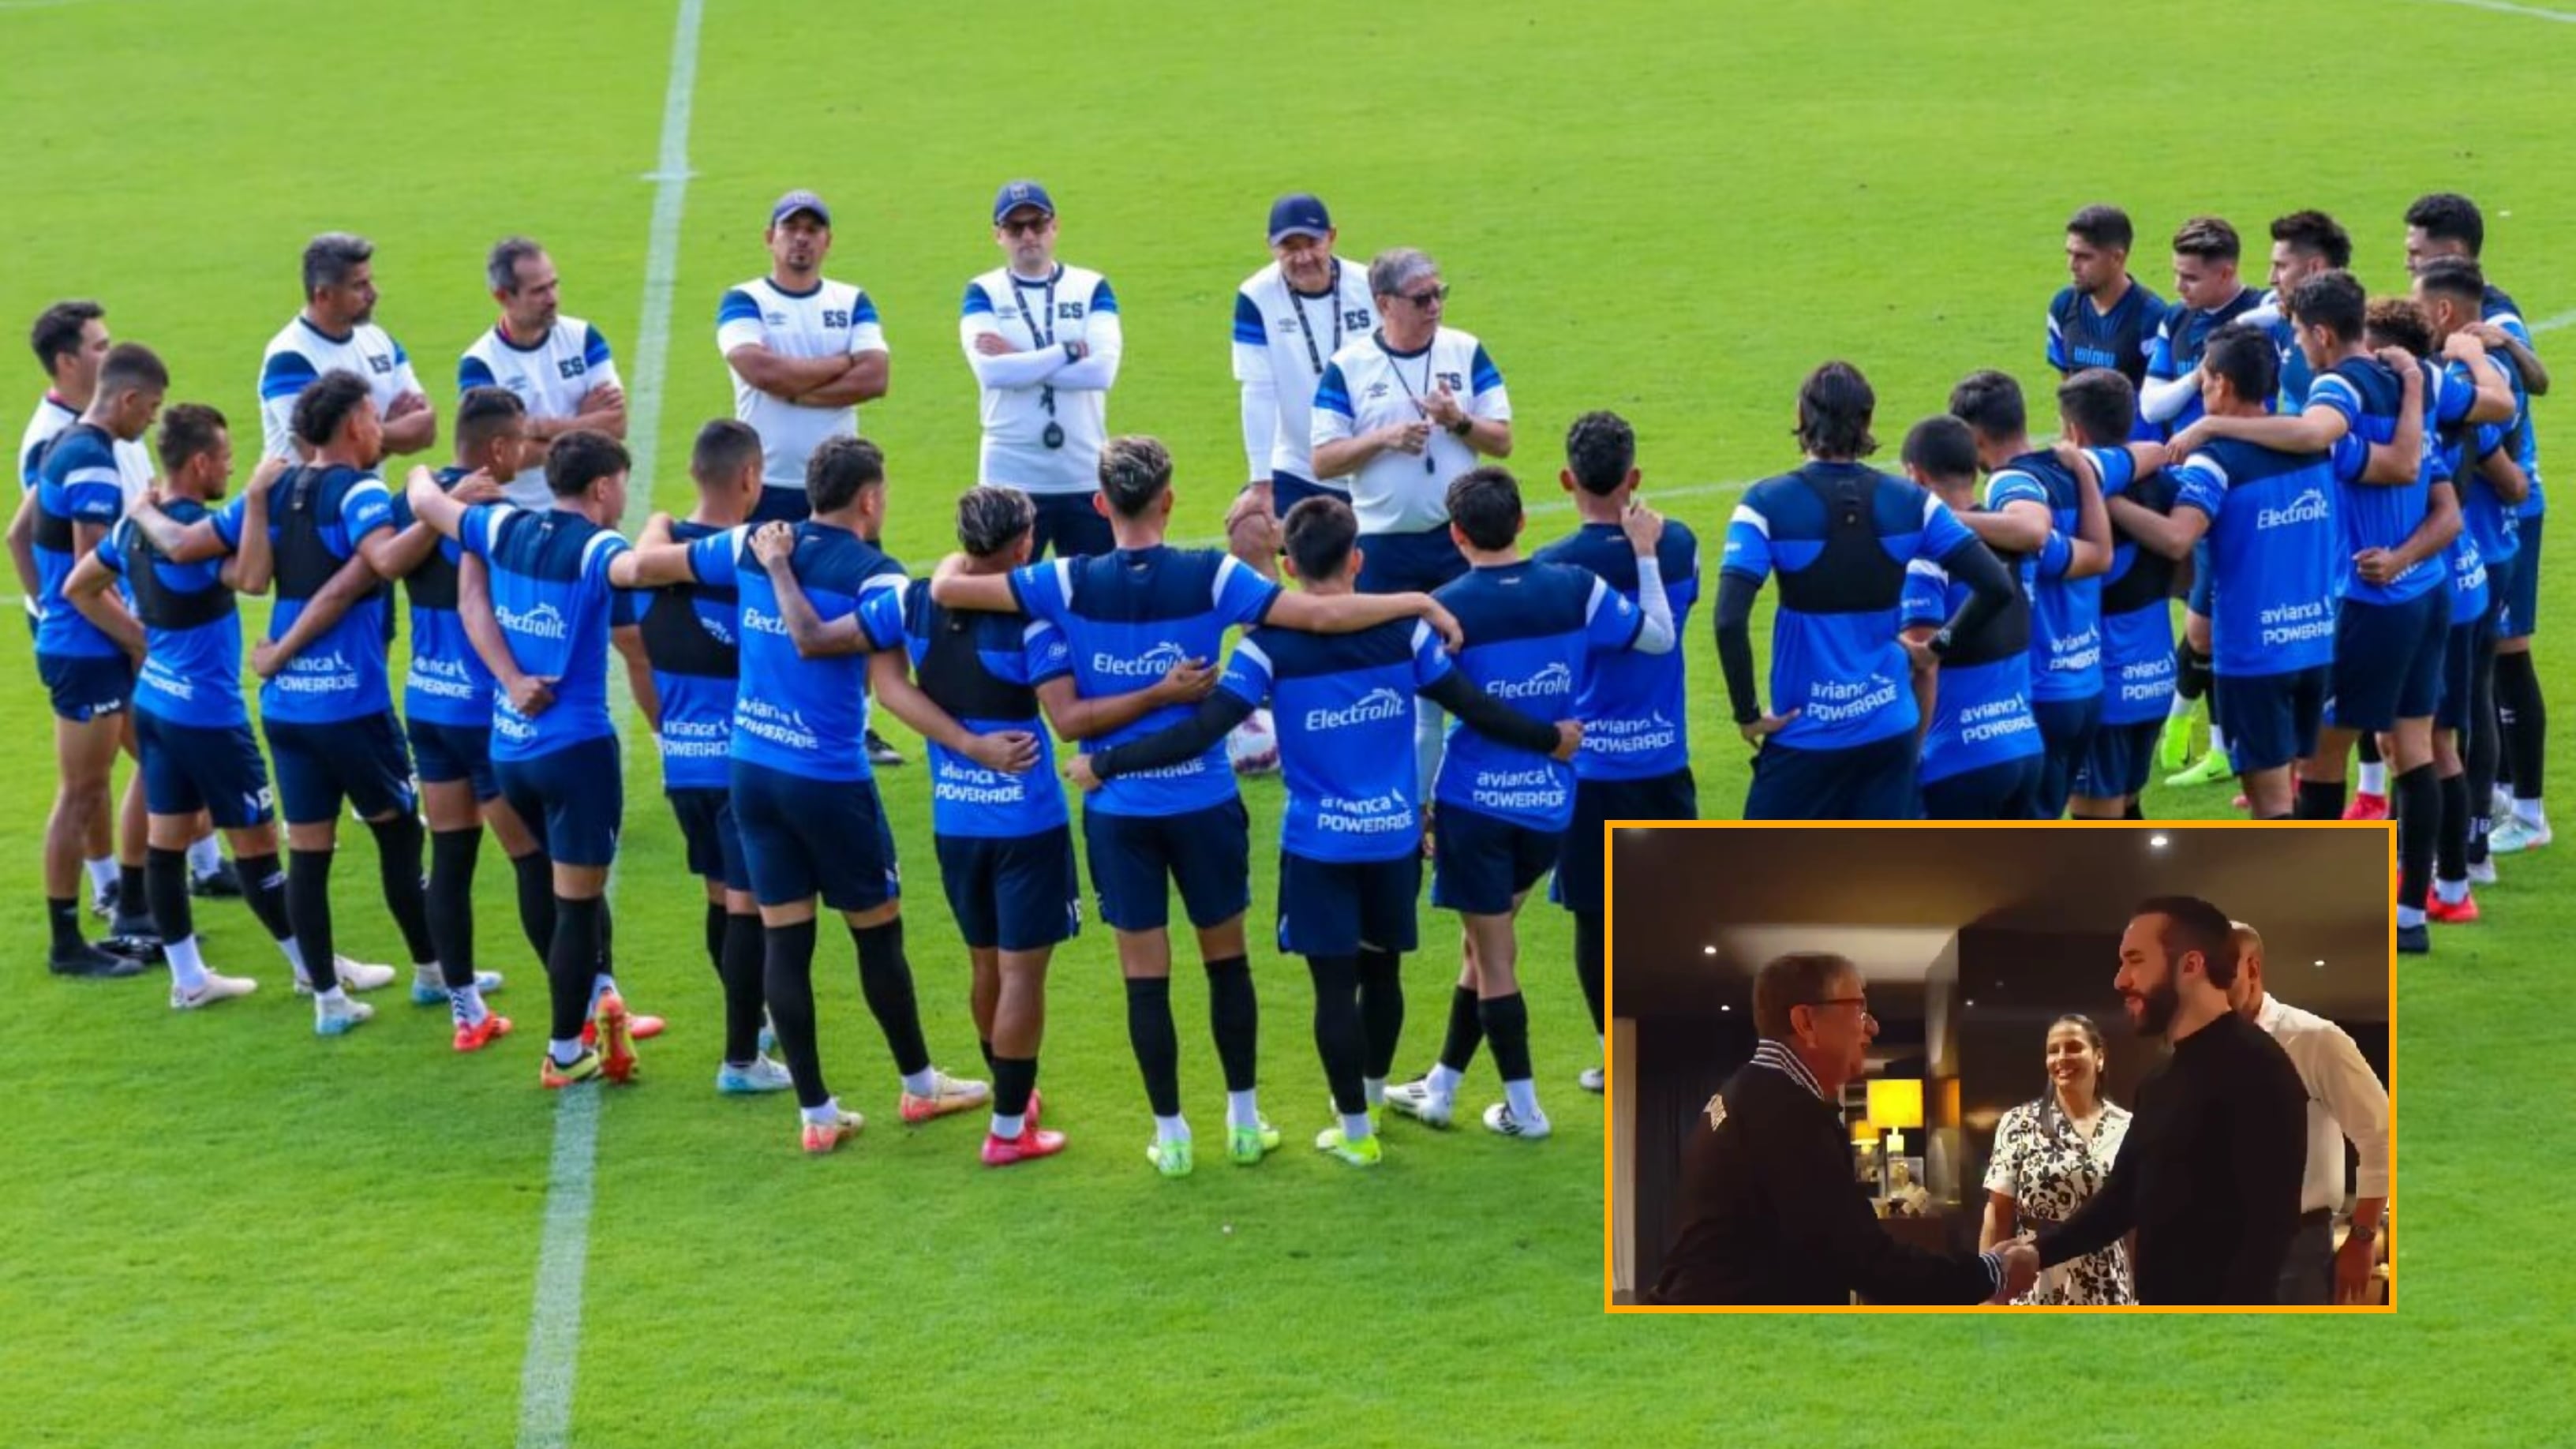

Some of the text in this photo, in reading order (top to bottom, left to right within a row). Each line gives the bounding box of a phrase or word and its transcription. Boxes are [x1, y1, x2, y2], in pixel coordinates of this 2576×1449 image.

[822, 309, 848, 328] ES
[1058, 301, 1084, 319] ES
[1343, 309, 1371, 331] ES
[557, 355, 585, 380] ES
[1436, 373, 1462, 391] S
[2263, 618, 2334, 646] POWERA
[1306, 695, 1406, 732] Electrolit
[1807, 683, 1897, 722] POWERADE
[663, 740, 729, 757] OWERAD
[1318, 808, 1413, 834] POWERADE
